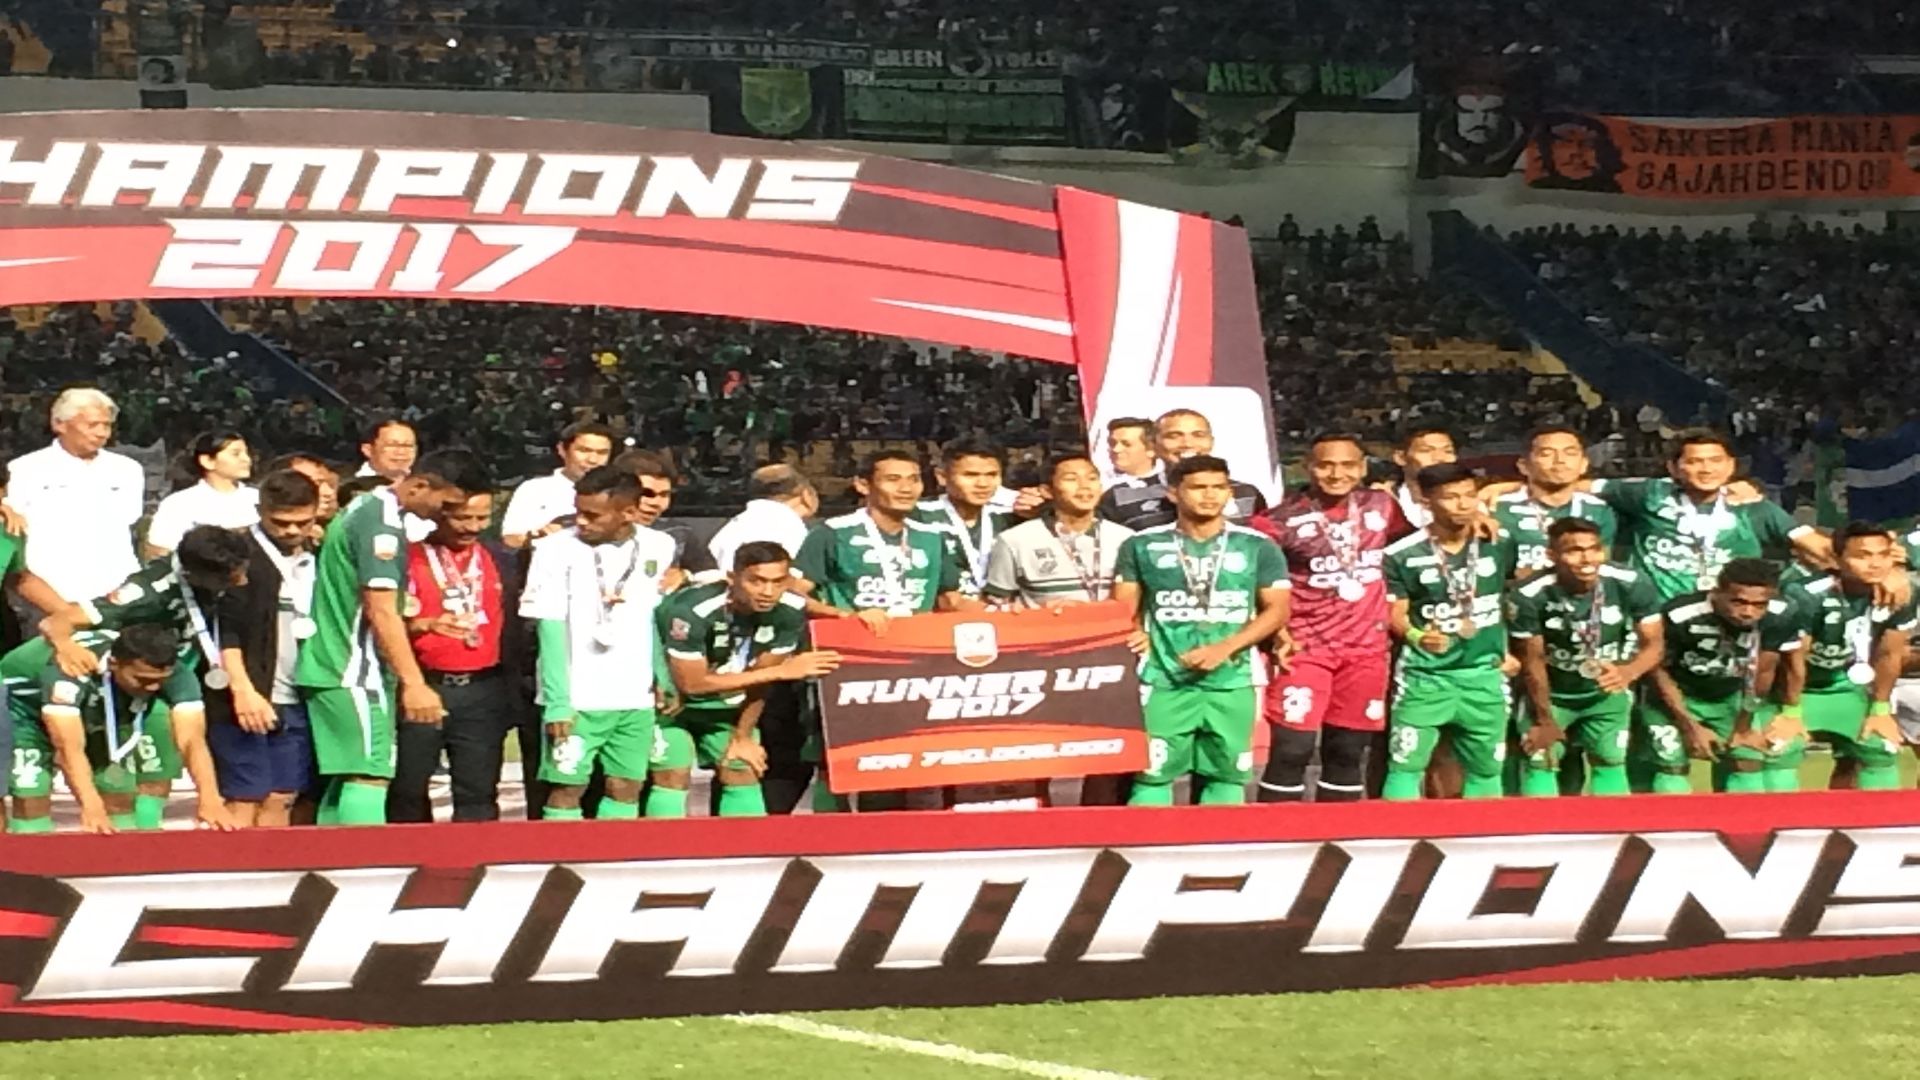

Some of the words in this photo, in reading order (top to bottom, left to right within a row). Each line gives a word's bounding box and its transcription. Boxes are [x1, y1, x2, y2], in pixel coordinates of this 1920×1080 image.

[873, 49, 944, 68] GREEN
[1206, 62, 1278, 94] AREK
[1628, 125, 1775, 155] SAKERA
[1791, 121, 1895, 153] MANIA
[150, 218, 579, 292] 2017
[837, 669, 1047, 705] RUNNER
[1053, 665, 1125, 692] UP
[926, 693, 1047, 721] 2017
[13, 748, 41, 771] 12
